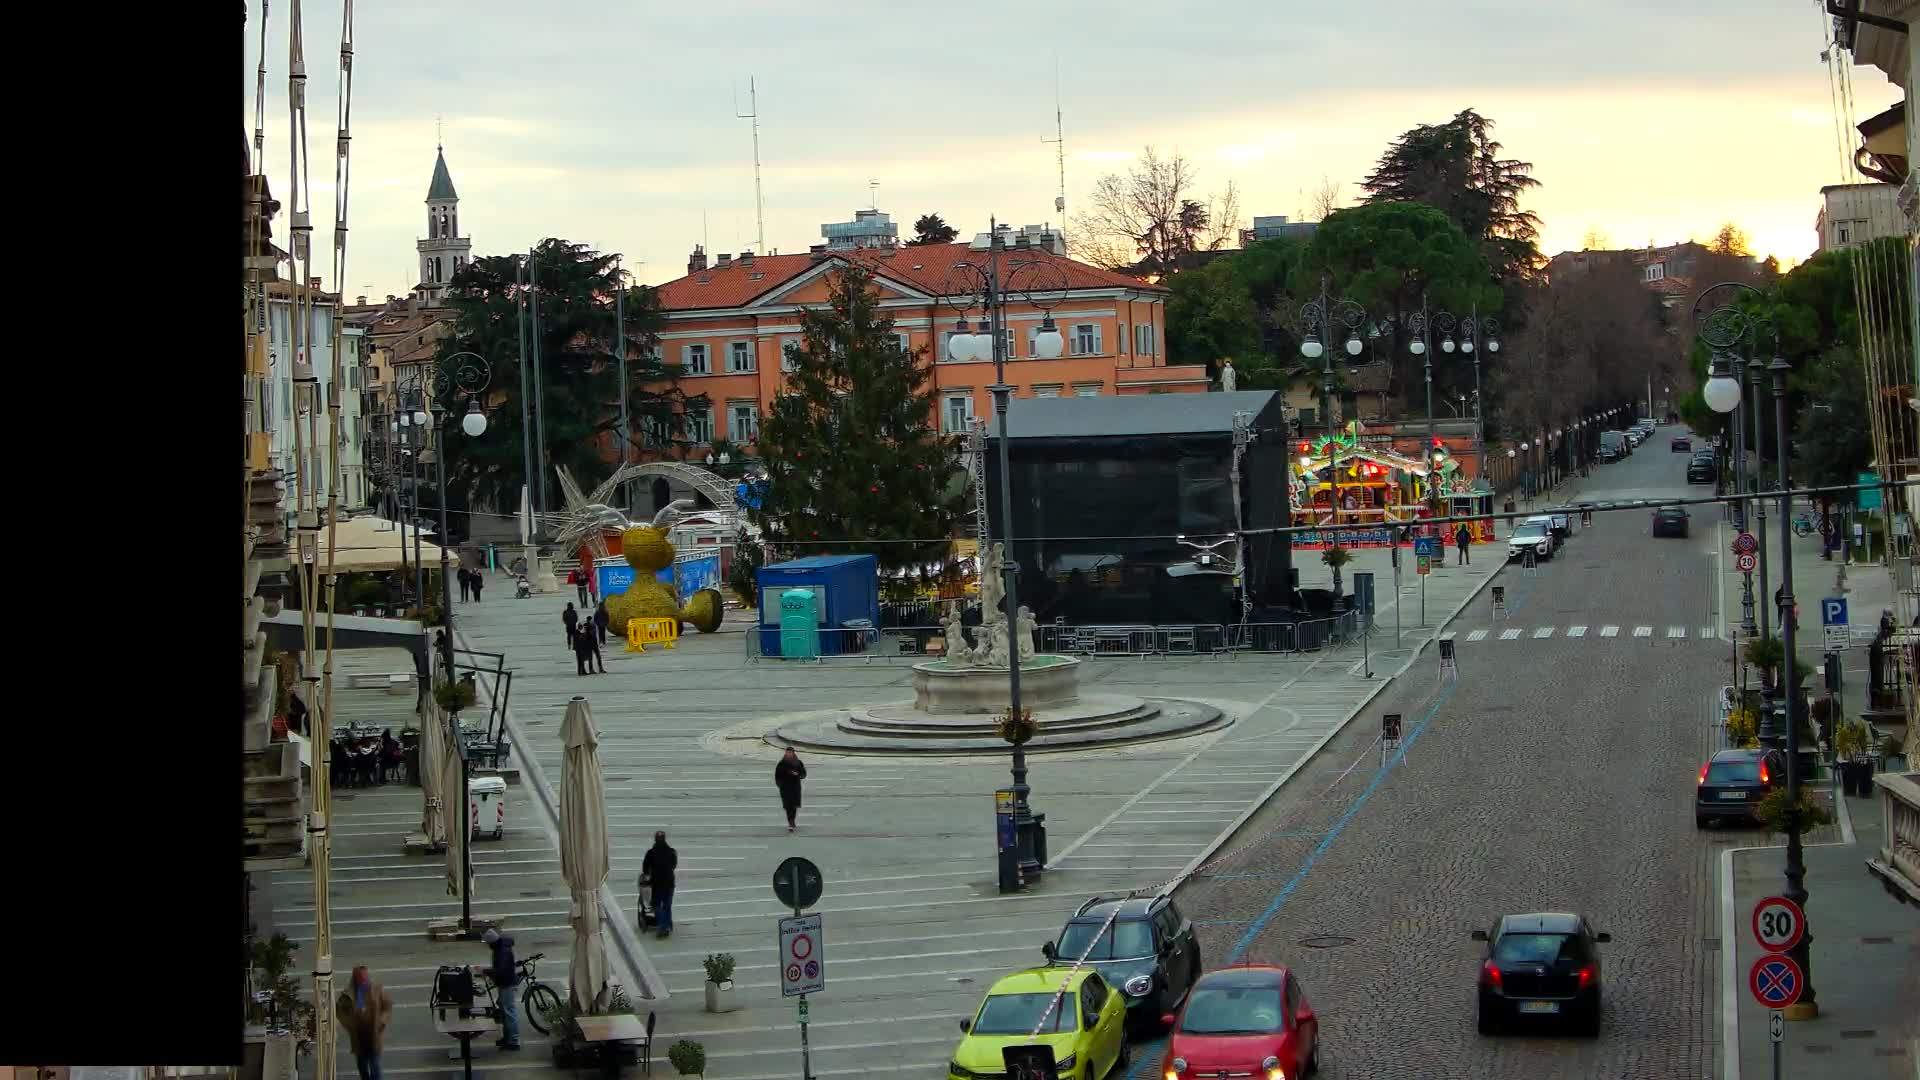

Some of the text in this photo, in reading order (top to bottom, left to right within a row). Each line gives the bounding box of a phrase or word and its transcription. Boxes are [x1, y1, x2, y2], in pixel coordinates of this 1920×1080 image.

[1742, 557, 1753, 567] 20
[1827, 602, 1842, 622] P
[1762, 911, 1792, 938] 30
[790, 969, 799, 978] 20
